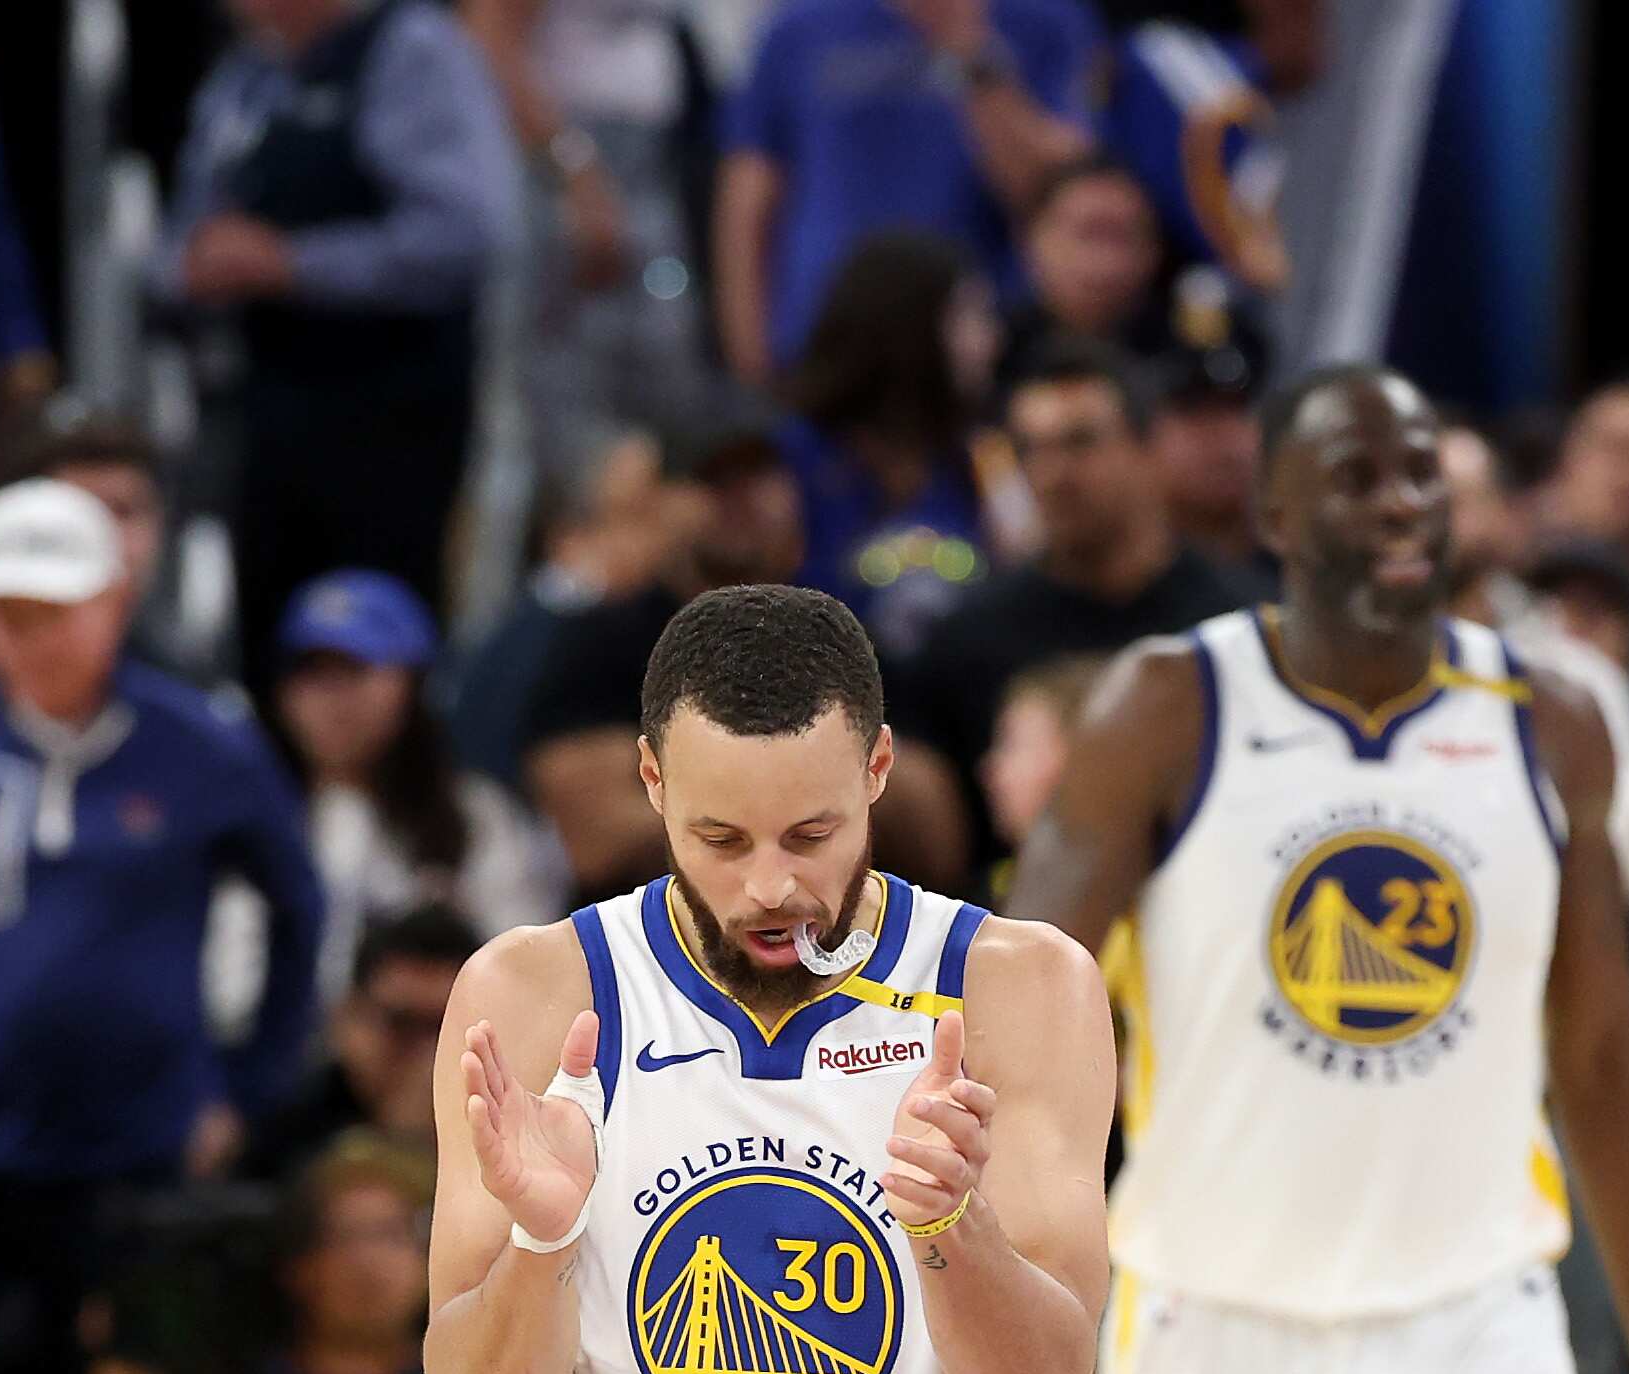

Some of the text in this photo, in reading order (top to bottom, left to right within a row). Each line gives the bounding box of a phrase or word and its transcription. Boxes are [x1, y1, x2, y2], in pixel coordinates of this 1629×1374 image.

[1377, 876, 1459, 949] 23
[818, 1040, 926, 1070] Rakuten
[633, 1136, 897, 1229] GOLDEN STATE
[772, 1238, 866, 1314] 30
